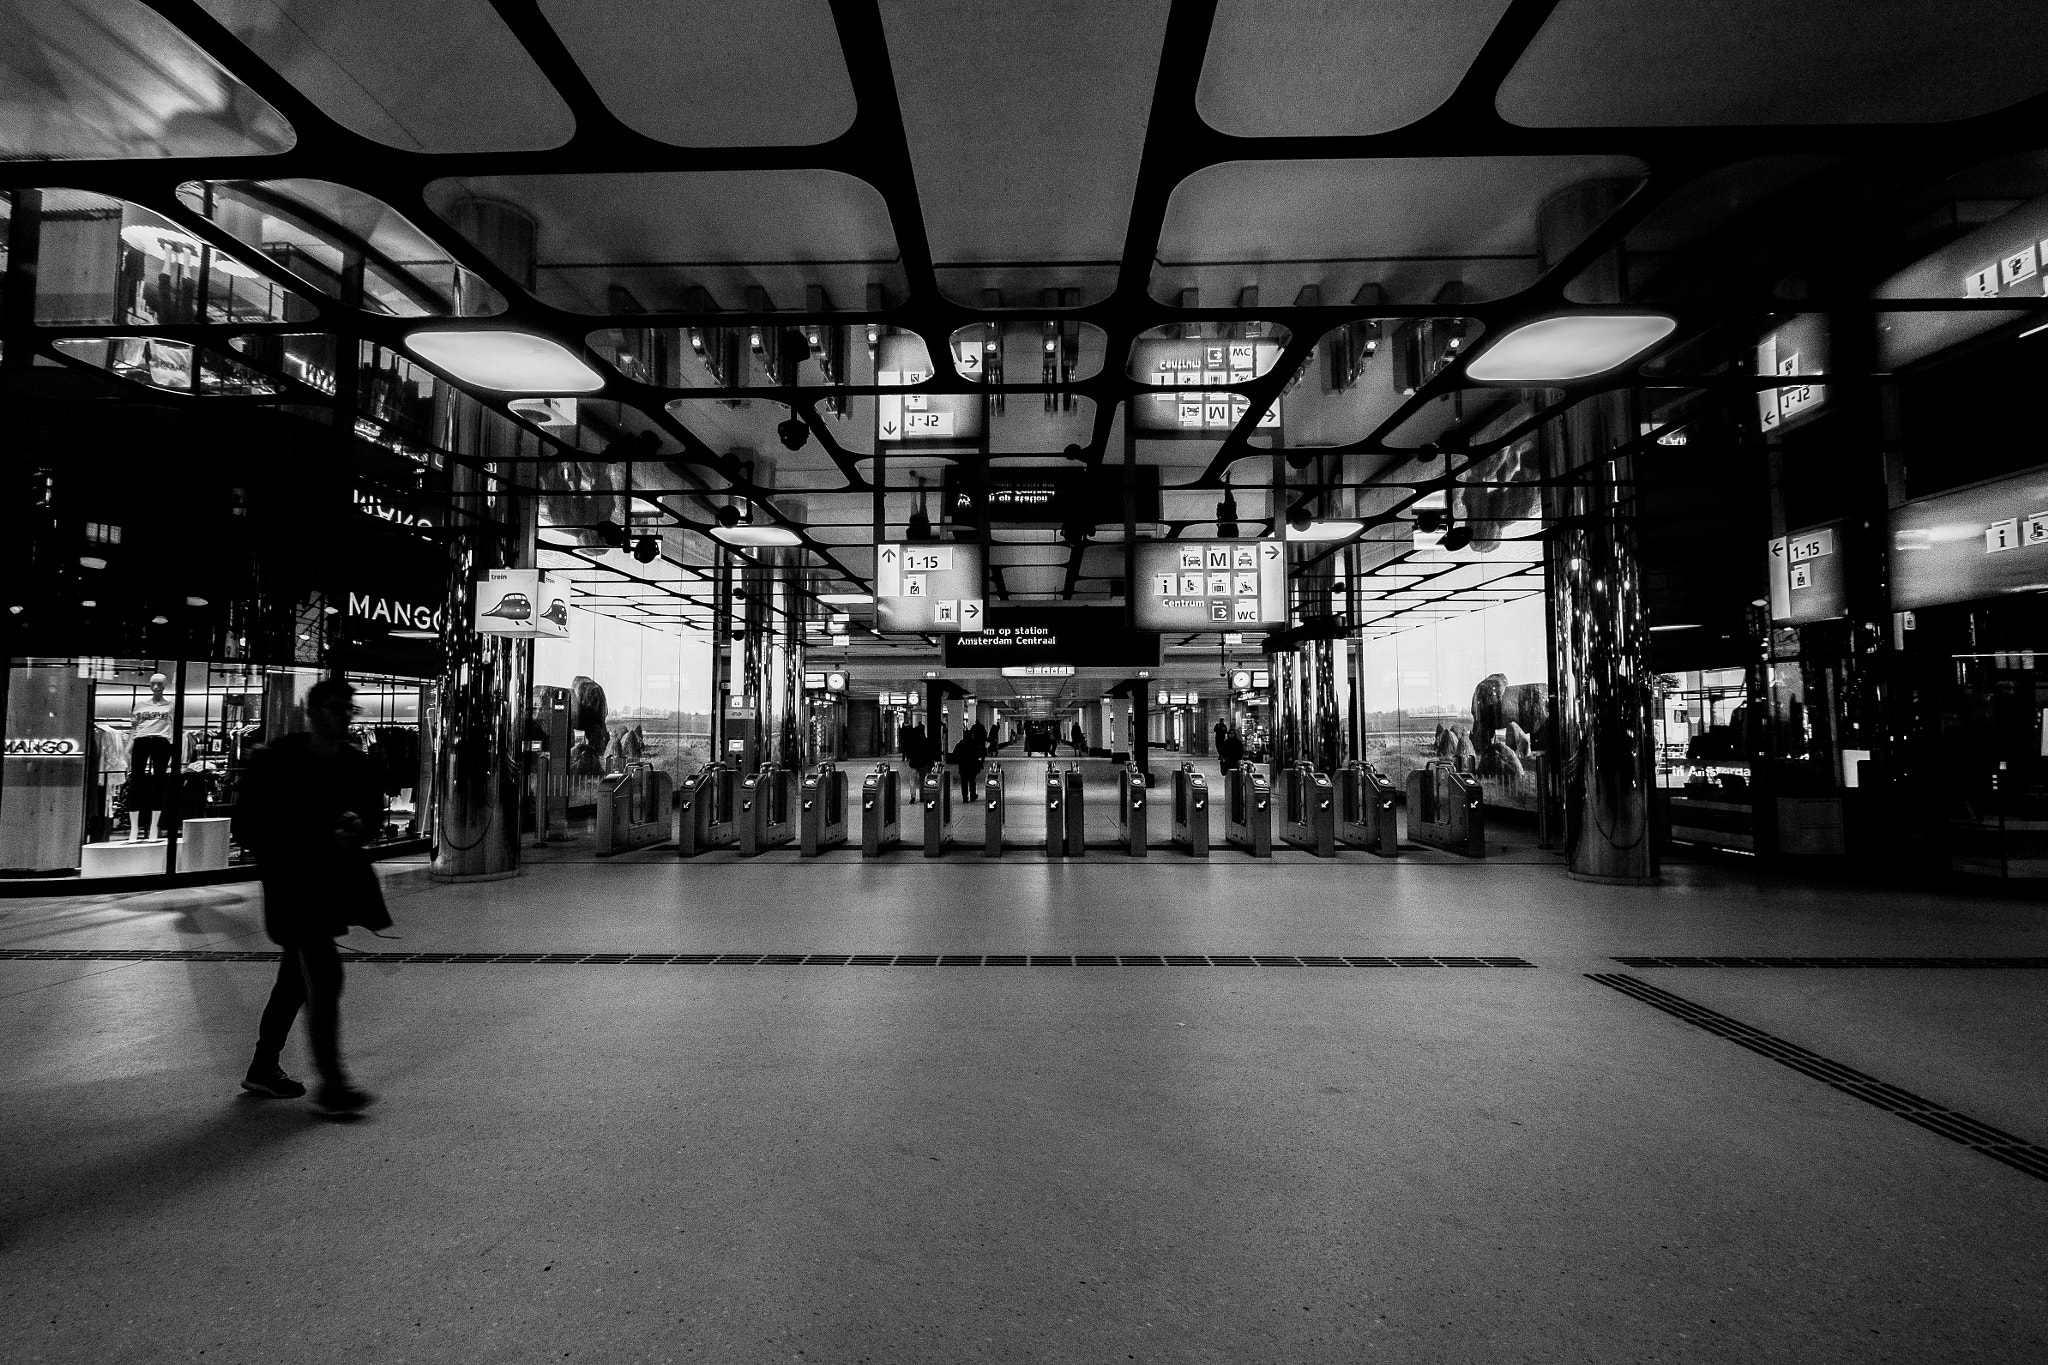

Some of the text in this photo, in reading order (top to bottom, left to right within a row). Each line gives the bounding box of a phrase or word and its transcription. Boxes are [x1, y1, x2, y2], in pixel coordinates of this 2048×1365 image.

[1793, 541, 1820, 559] 1-15
[907, 556, 938, 569] 1-15
[1210, 552, 1227, 567] M
[1162, 598, 1205, 608] Centrum
[1237, 611, 1256, 620] WC
[999, 628, 1011, 637] op
[1014, 626, 1048, 635] station
[957, 636, 1056, 646] Amsterdam Centraal
